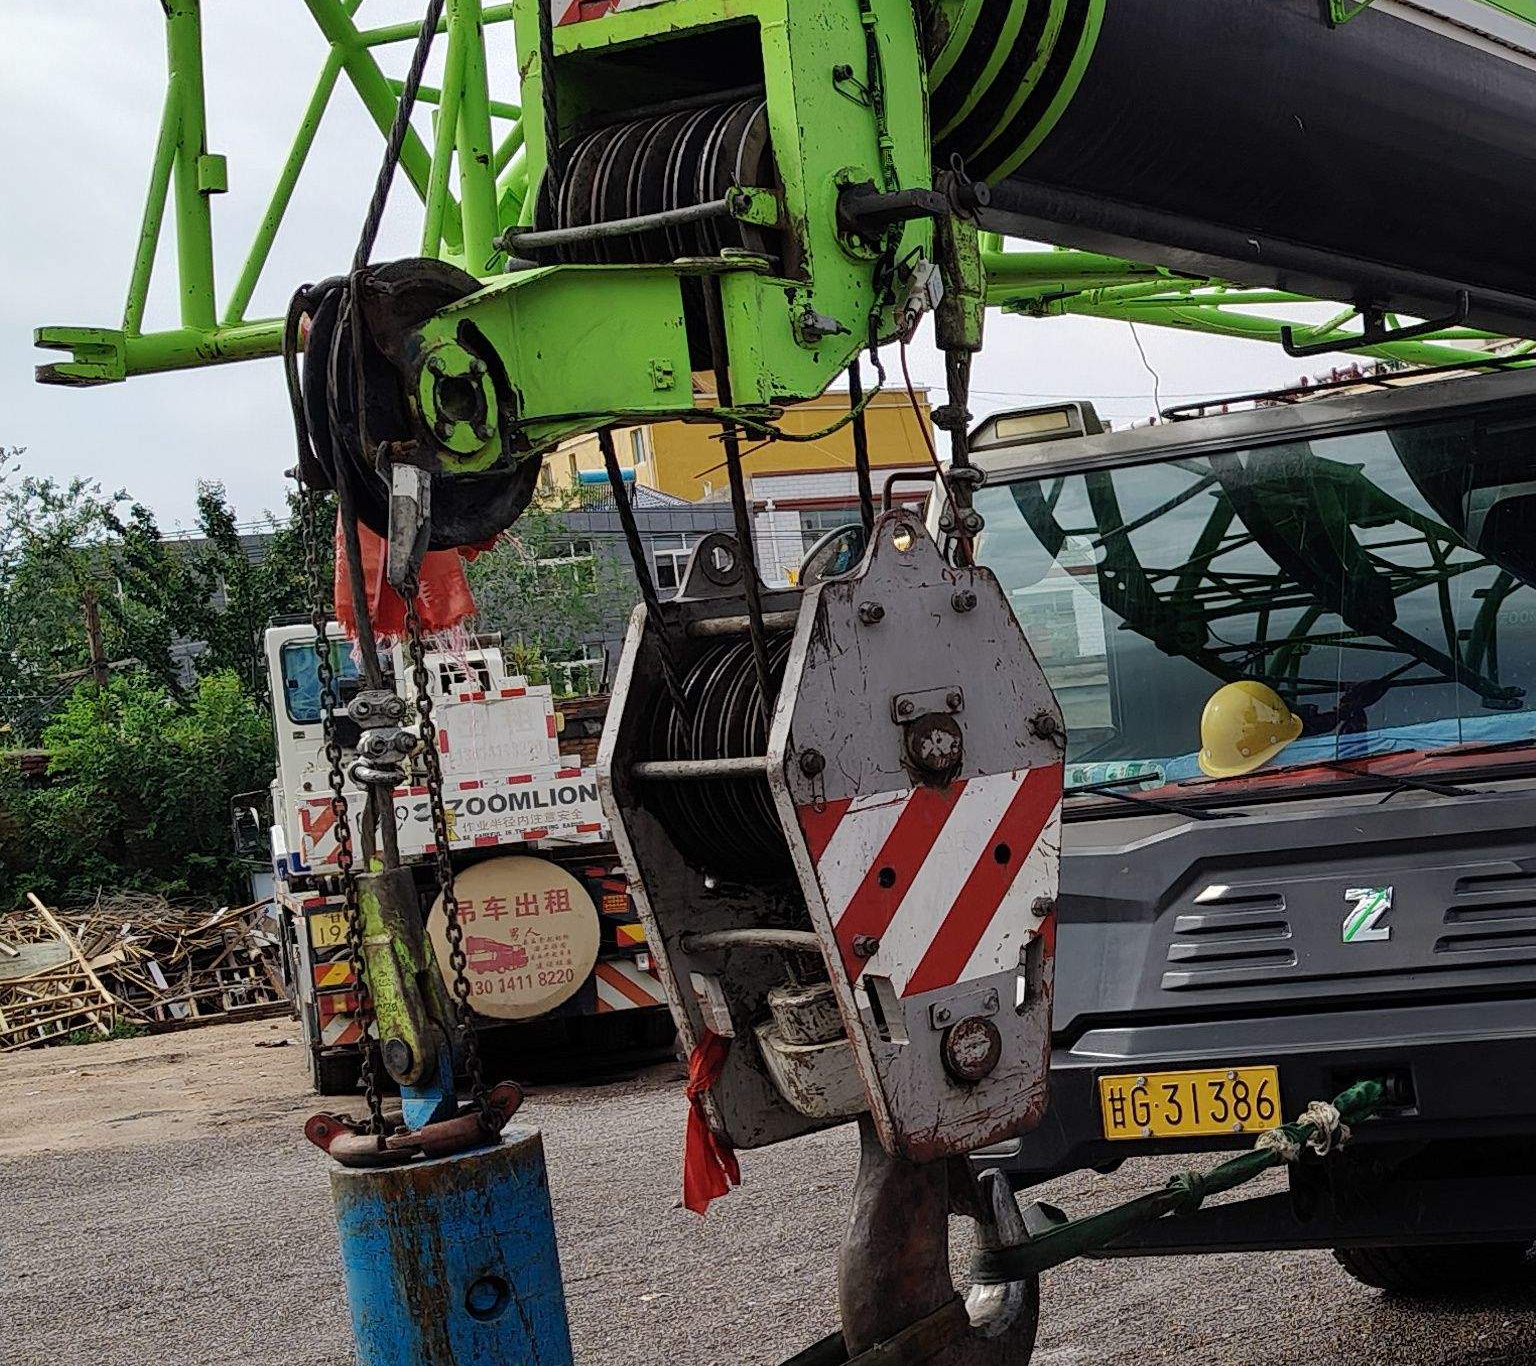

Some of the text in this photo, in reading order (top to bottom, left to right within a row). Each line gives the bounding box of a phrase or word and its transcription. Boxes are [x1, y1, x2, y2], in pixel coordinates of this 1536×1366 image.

[445, 784, 599, 819] ZOOMLION
[456, 888, 572, 925] 吊车出租
[537, 968, 575, 987] 8220
[1108, 1078, 1276, 1129] 甘G·31386
